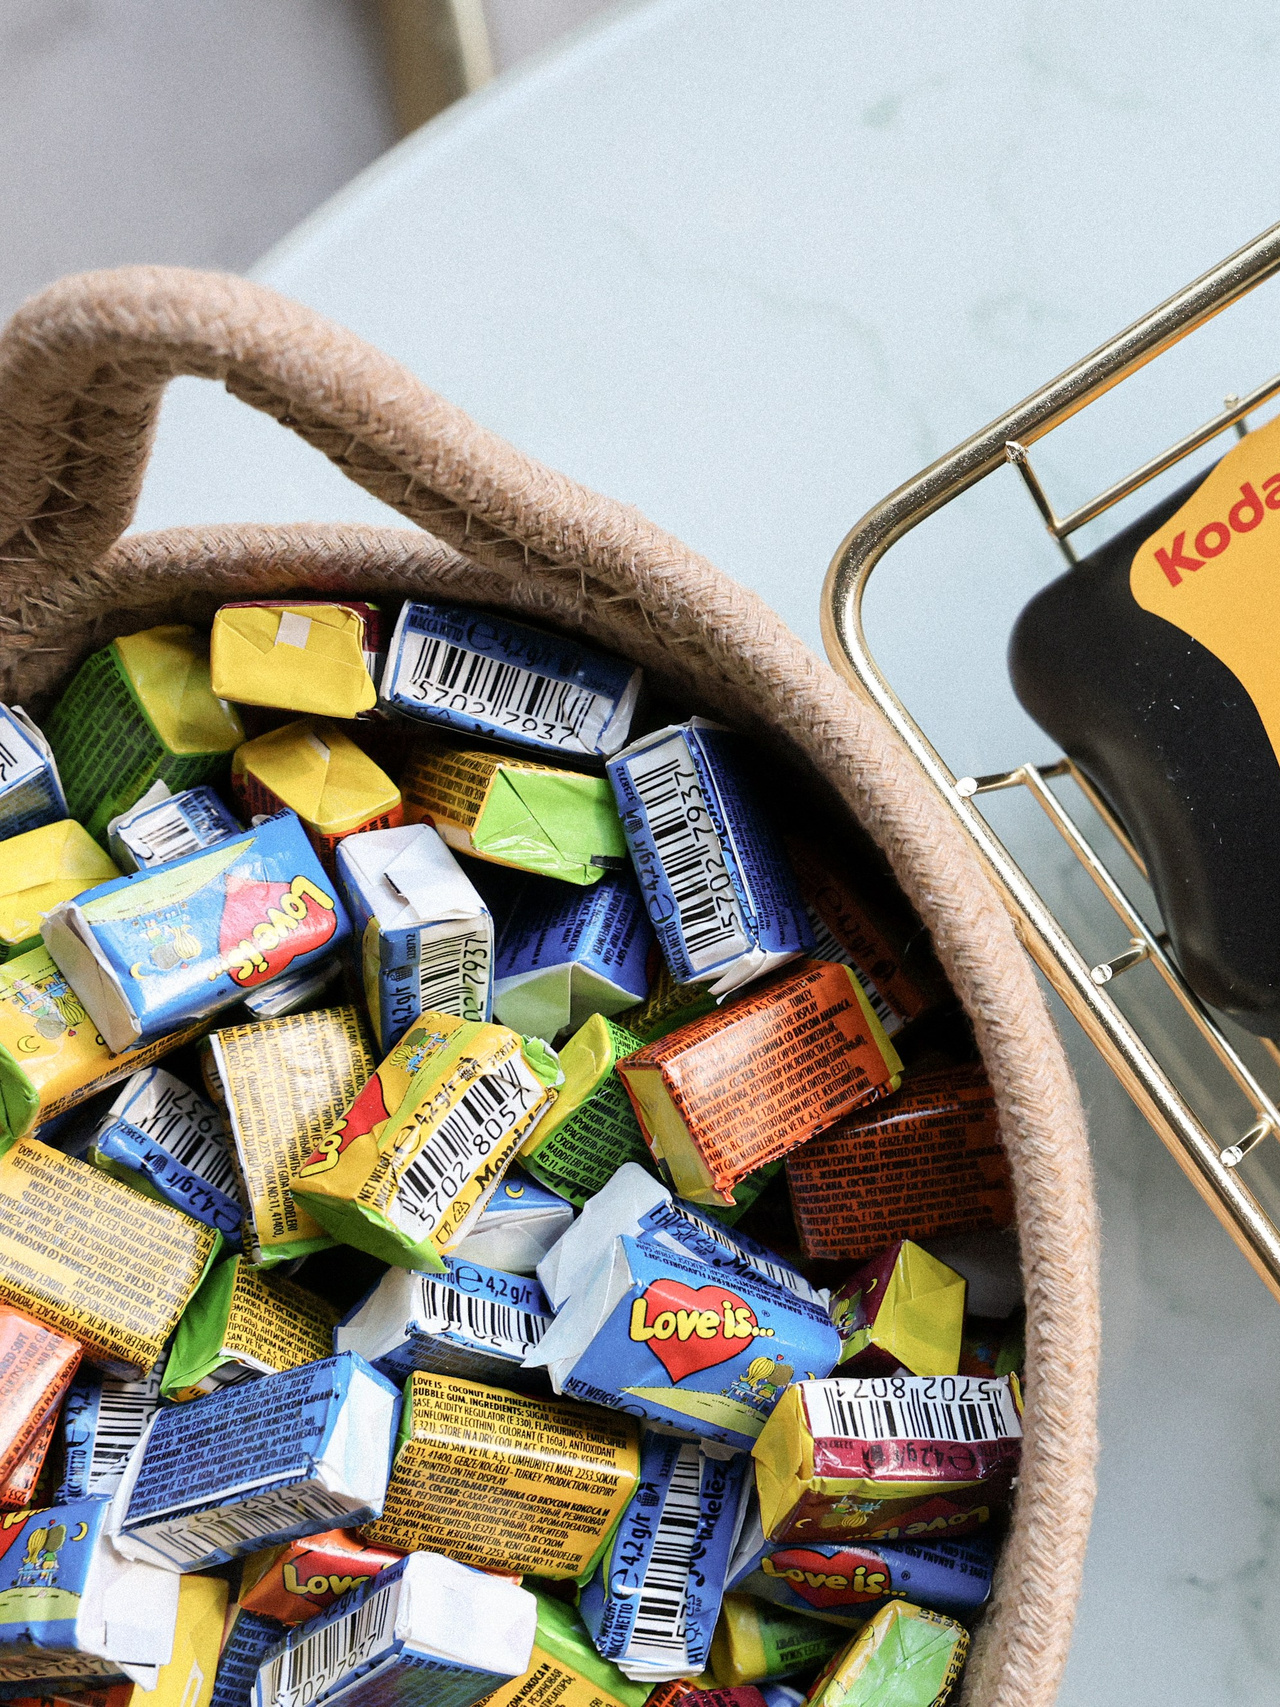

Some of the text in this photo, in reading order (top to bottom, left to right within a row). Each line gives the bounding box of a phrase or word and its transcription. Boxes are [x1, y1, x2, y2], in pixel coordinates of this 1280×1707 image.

[505, 710, 576, 746] 7937
[615, 765, 638, 803] 3238712
[632, 839, 663, 892] 4,2 g/r
[678, 769, 740, 940] 5702 7937
[208, 874, 335, 982] Love is...
[460, 936, 488, 984] 7937
[389, 984, 417, 1025] 4,2 g/r
[787, 988, 815, 1009] TURKEY.
[751, 998, 854, 1061] РЕЗИНКА СО ВКУСОМ АНАНАСА.
[414, 1078, 459, 1128] 4,2 g/r
[417, 1090, 532, 1232] 5702 8057
[722, 1114, 810, 1171] GIDA MADDELERI SAN. VE TIC.
[10, 1155, 92, 1203] KENT GIDA MADDELERI
[17, 1139, 112, 1197] 2253. SOKAK NO:11, 41400,
[165, 1168, 220, 1216] 4,2 g/r
[267, 1185, 285, 1239] NO:11, 41400,
[274, 1150, 299, 1232] KENT GIDA MADDELERI
[357, 1179, 379, 1204] NET
[641, 1249, 663, 1263] SOFT
[484, 1274, 533, 1307] 4,2 g/r
[753, 1291, 772, 1304] AND
[34, 1303, 132, 1360] STORE IN A DRY COOL PLACE.
[629, 1297, 775, 1342] Love is...
[410, 1376, 504, 1403] LOVE IS COCONUT AND
[412, 1387, 552, 1424] BUBBLE GUM. INGREDIENTS: SUGAR,
[564, 1377, 624, 1408] NET WEIGHT
[833, 1375, 991, 1402] 5702 8071
[434, 1400, 587, 1442] ACIDITY REGULATOR (E 330), FLAVOURINGS,
[460, 1416, 617, 1459] LECITHIN), COLORANT (E 160a), ANTIOXIDANT
[417, 1459, 509, 1486] PRINTED ON THE DISPLAY
[427, 1450, 617, 1497] 41400, GEBZE/KOCAELI TURKEY. PRODUCTION/EXPIRY
[919, 1444, 943, 1467] 4,2
[391, 1461, 611, 1517] LOVE IS ЖЕВАТЕЛЬНАЯ РЕЗИНКА СО ВКУСОМ КОКОСА И
[619, 1510, 656, 1568] 4,2 g/r
[760, 1556, 908, 1598] Love is...
[335, 1633, 377, 1679] 7937
